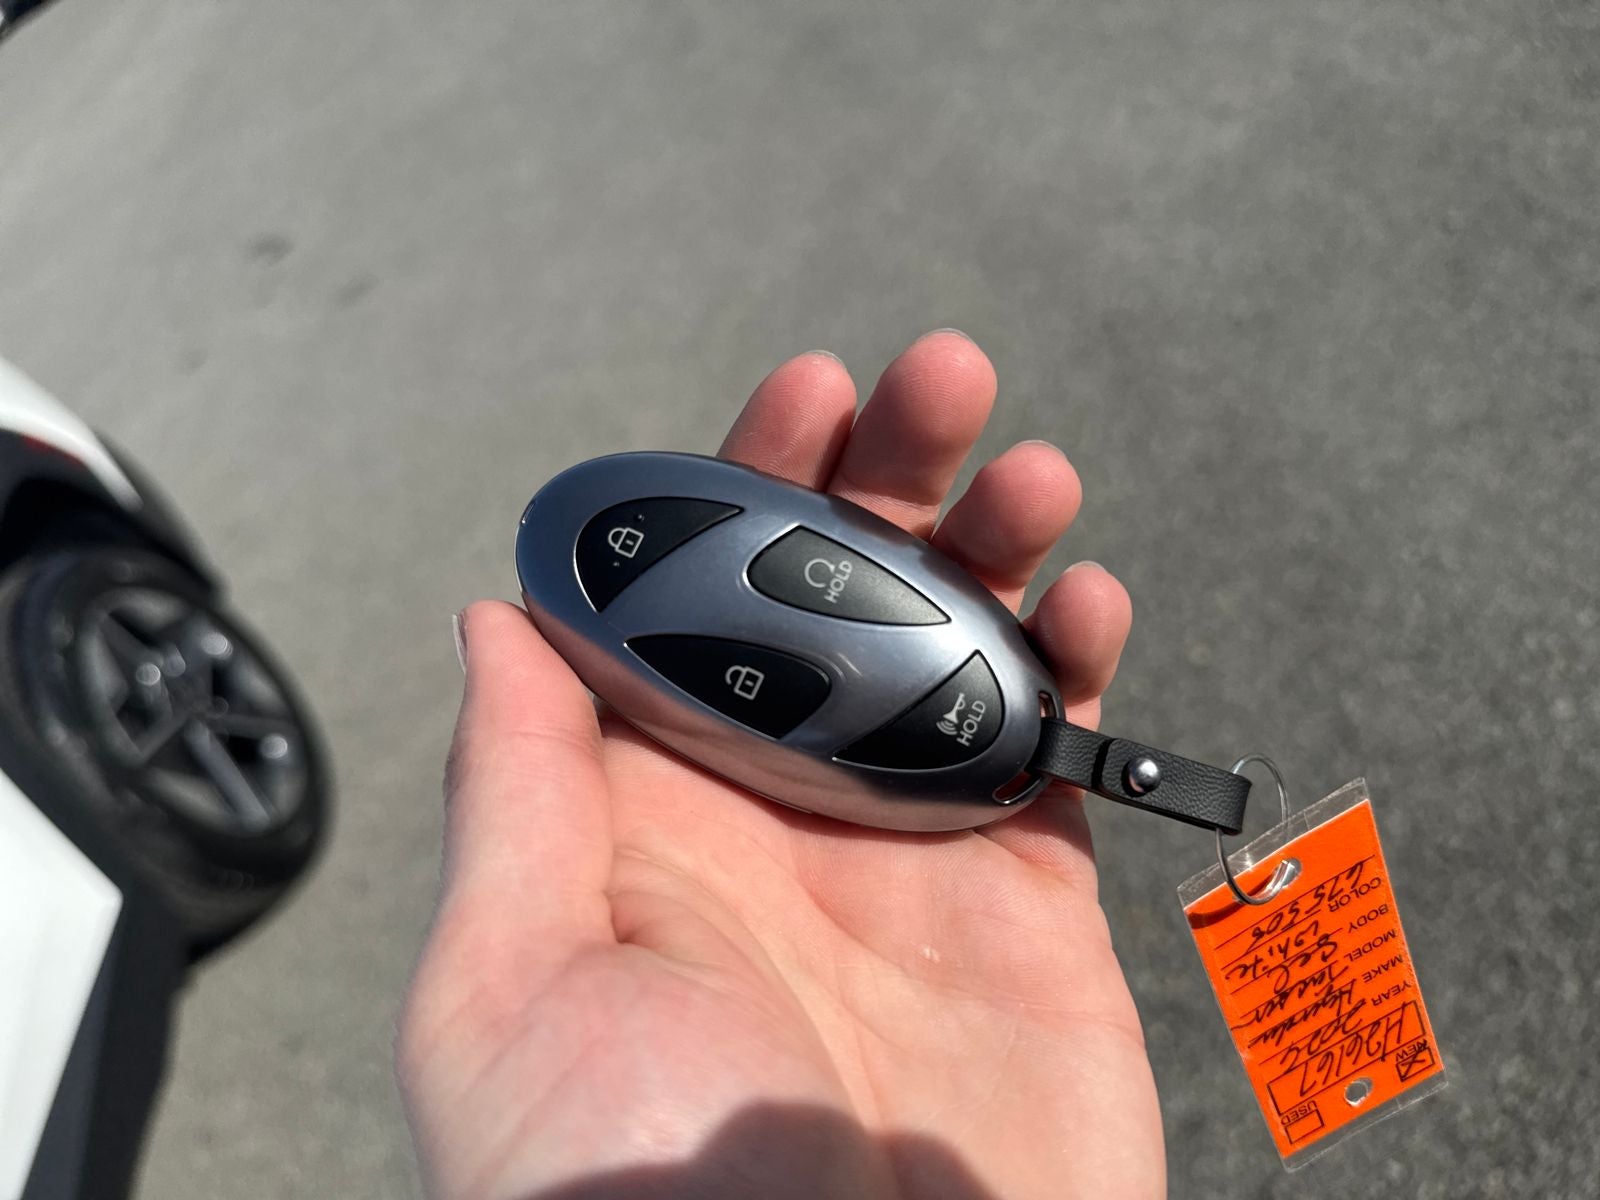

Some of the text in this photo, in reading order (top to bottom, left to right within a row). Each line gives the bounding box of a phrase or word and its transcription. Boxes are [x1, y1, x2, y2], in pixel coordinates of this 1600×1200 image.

[824, 560, 852, 604] HOLD
[956, 700, 986, 747] HOLD
[1327, 876, 1382, 913] COLOR
[1348, 903, 1390, 933] BODY
[1344, 929, 1397, 962] MODEL
[1362, 954, 1404, 984] MAKE
[1371, 980, 1412, 1007] YEAR
[1394, 1038, 1428, 1061] NEW
[1280, 1100, 1318, 1126] USED
